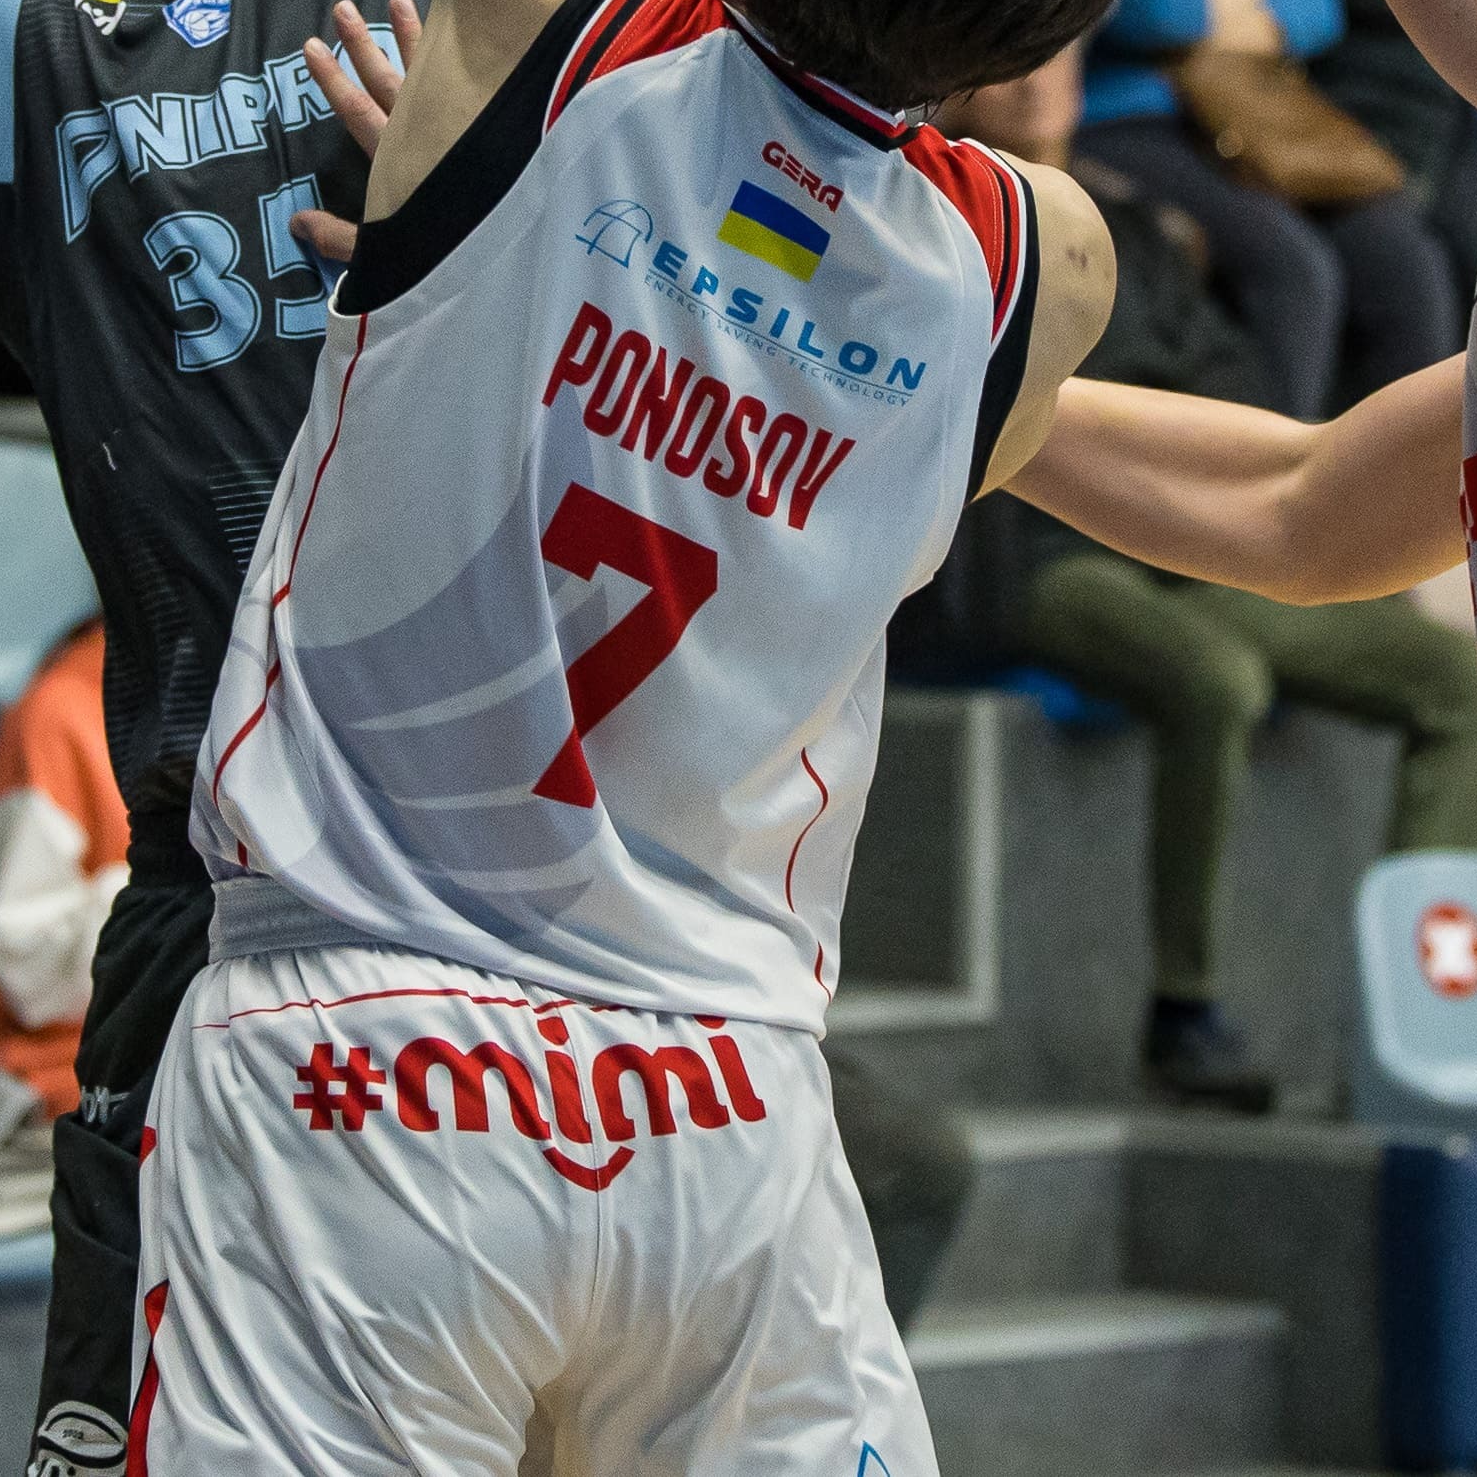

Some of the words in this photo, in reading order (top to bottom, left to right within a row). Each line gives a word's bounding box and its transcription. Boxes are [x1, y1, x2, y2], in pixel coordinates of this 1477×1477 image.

[761, 140, 845, 213] GERA
[143, 174, 330, 372] 35
[643, 273, 710, 321] ENERGY
[715, 318, 778, 357] SAVING
[788, 354, 910, 408] TECHNOLOGY
[651, 239, 927, 390] EPSILON
[541, 301, 857, 531] PONOSOV
[531, 480, 719, 809] 7
[293, 1014, 767, 1146] #mimi
